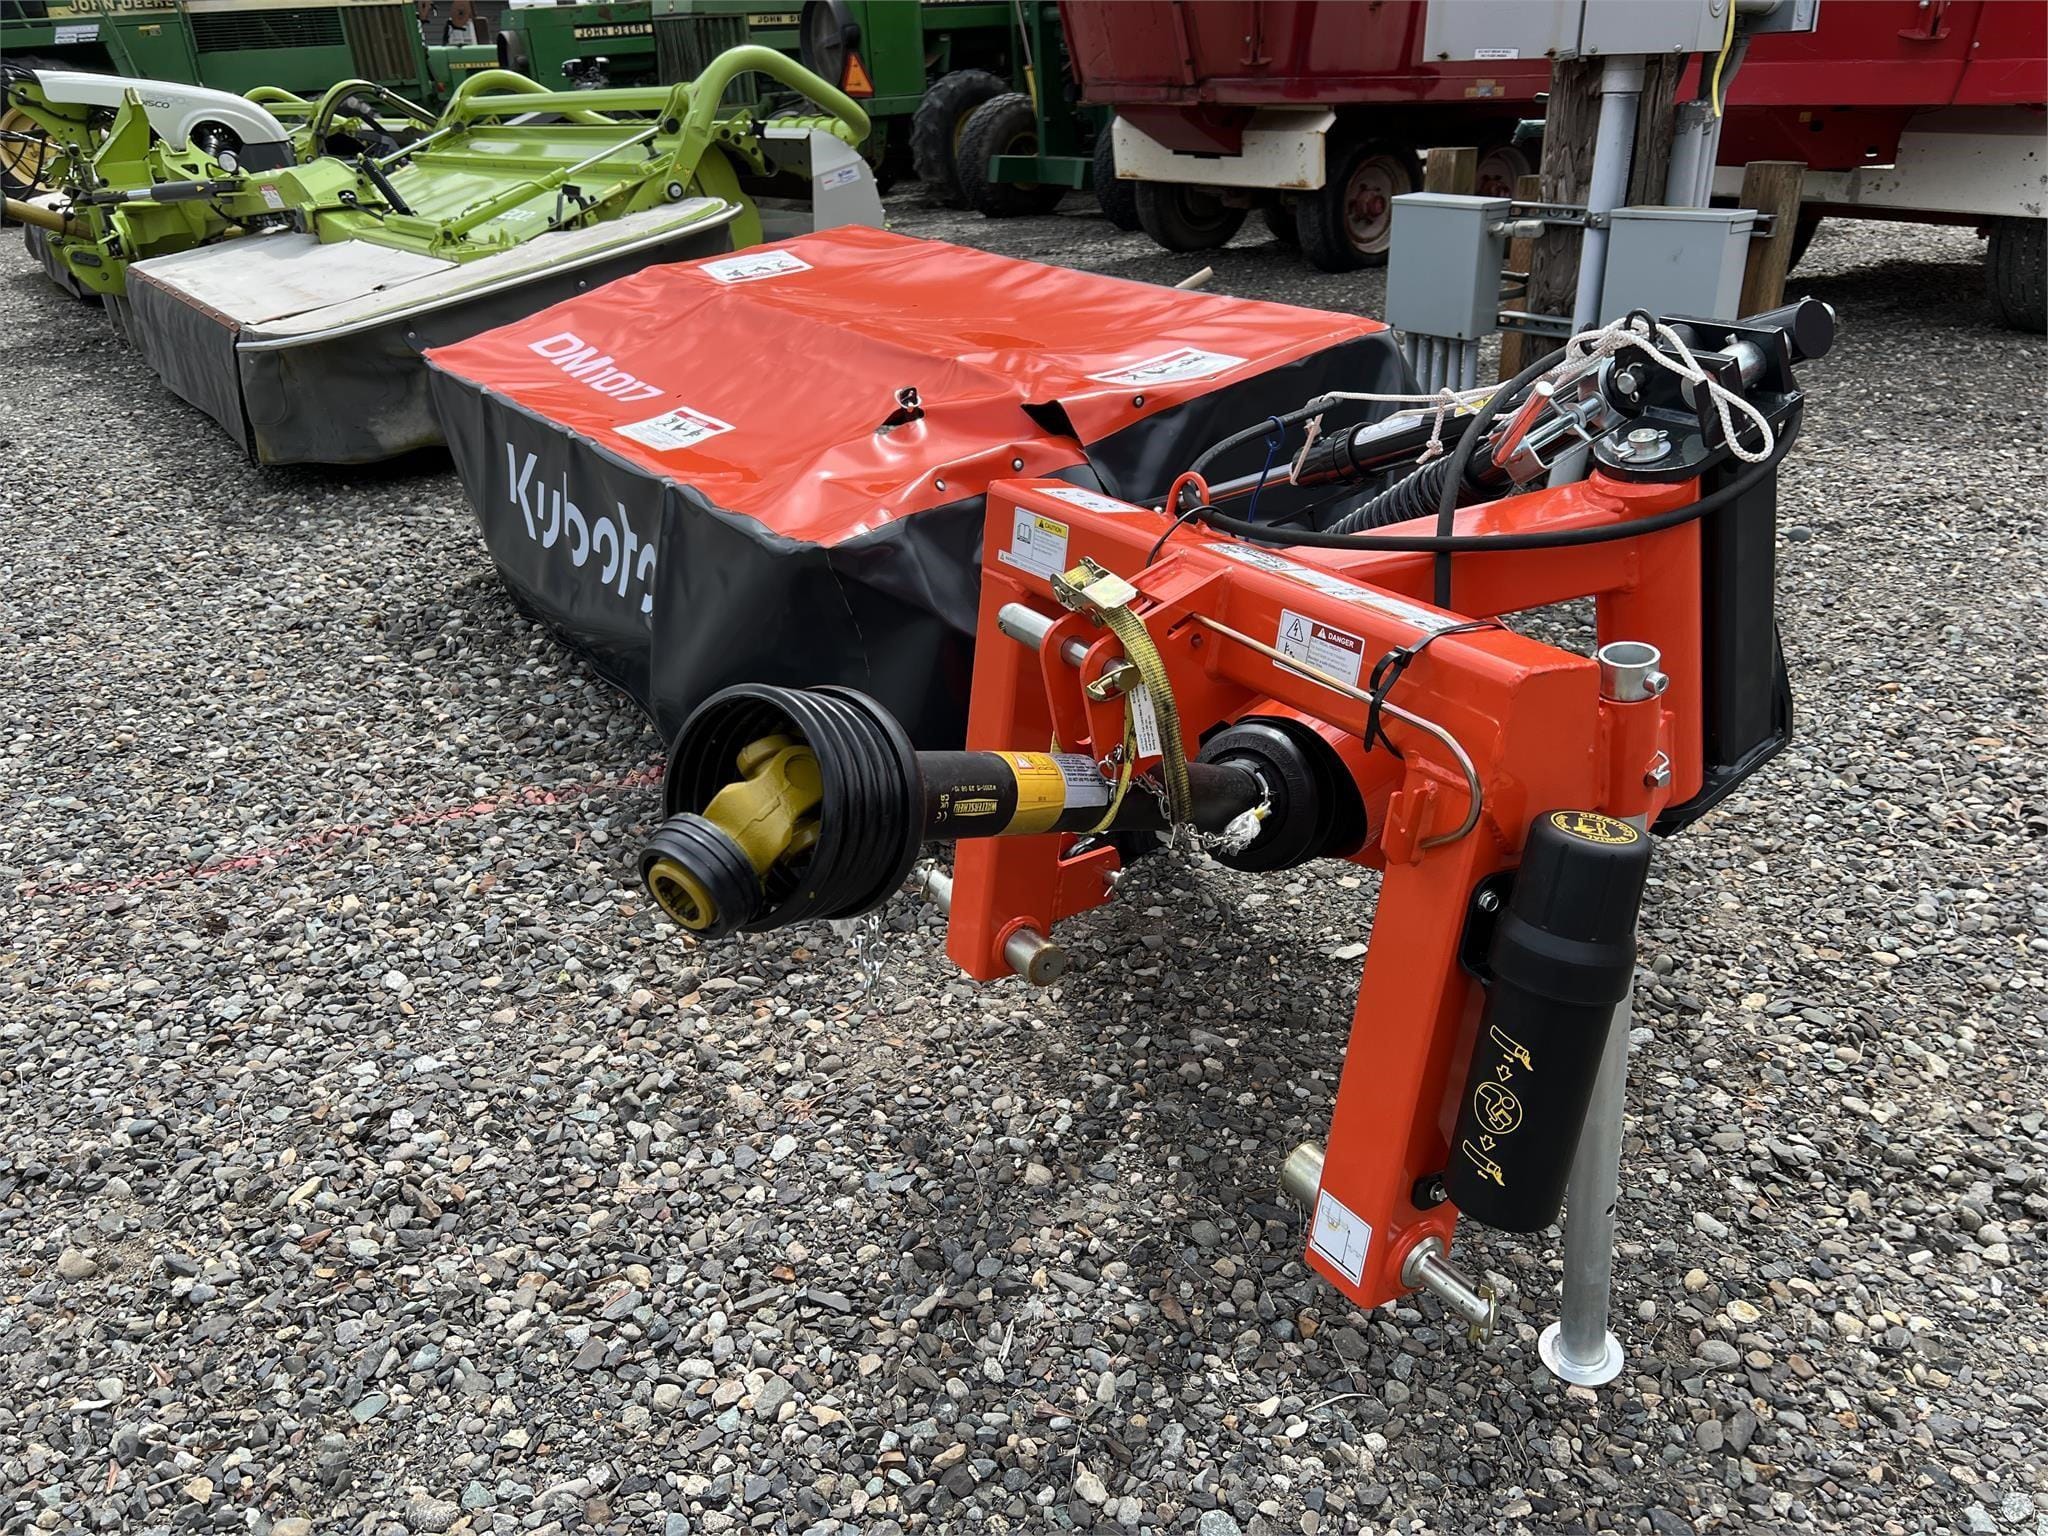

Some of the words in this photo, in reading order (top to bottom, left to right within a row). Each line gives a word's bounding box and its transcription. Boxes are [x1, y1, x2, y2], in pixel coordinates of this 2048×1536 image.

[757, 15, 782, 24] JOHN
[579, 27, 608, 38] JOHN
[614, 24, 647, 35] DEERE
[142, 99, 170, 108] ISCO
[528, 332, 666, 402] DM1017
[1045, 522, 1062, 533] CAUTION
[1328, 633, 1354, 648] DANGER
